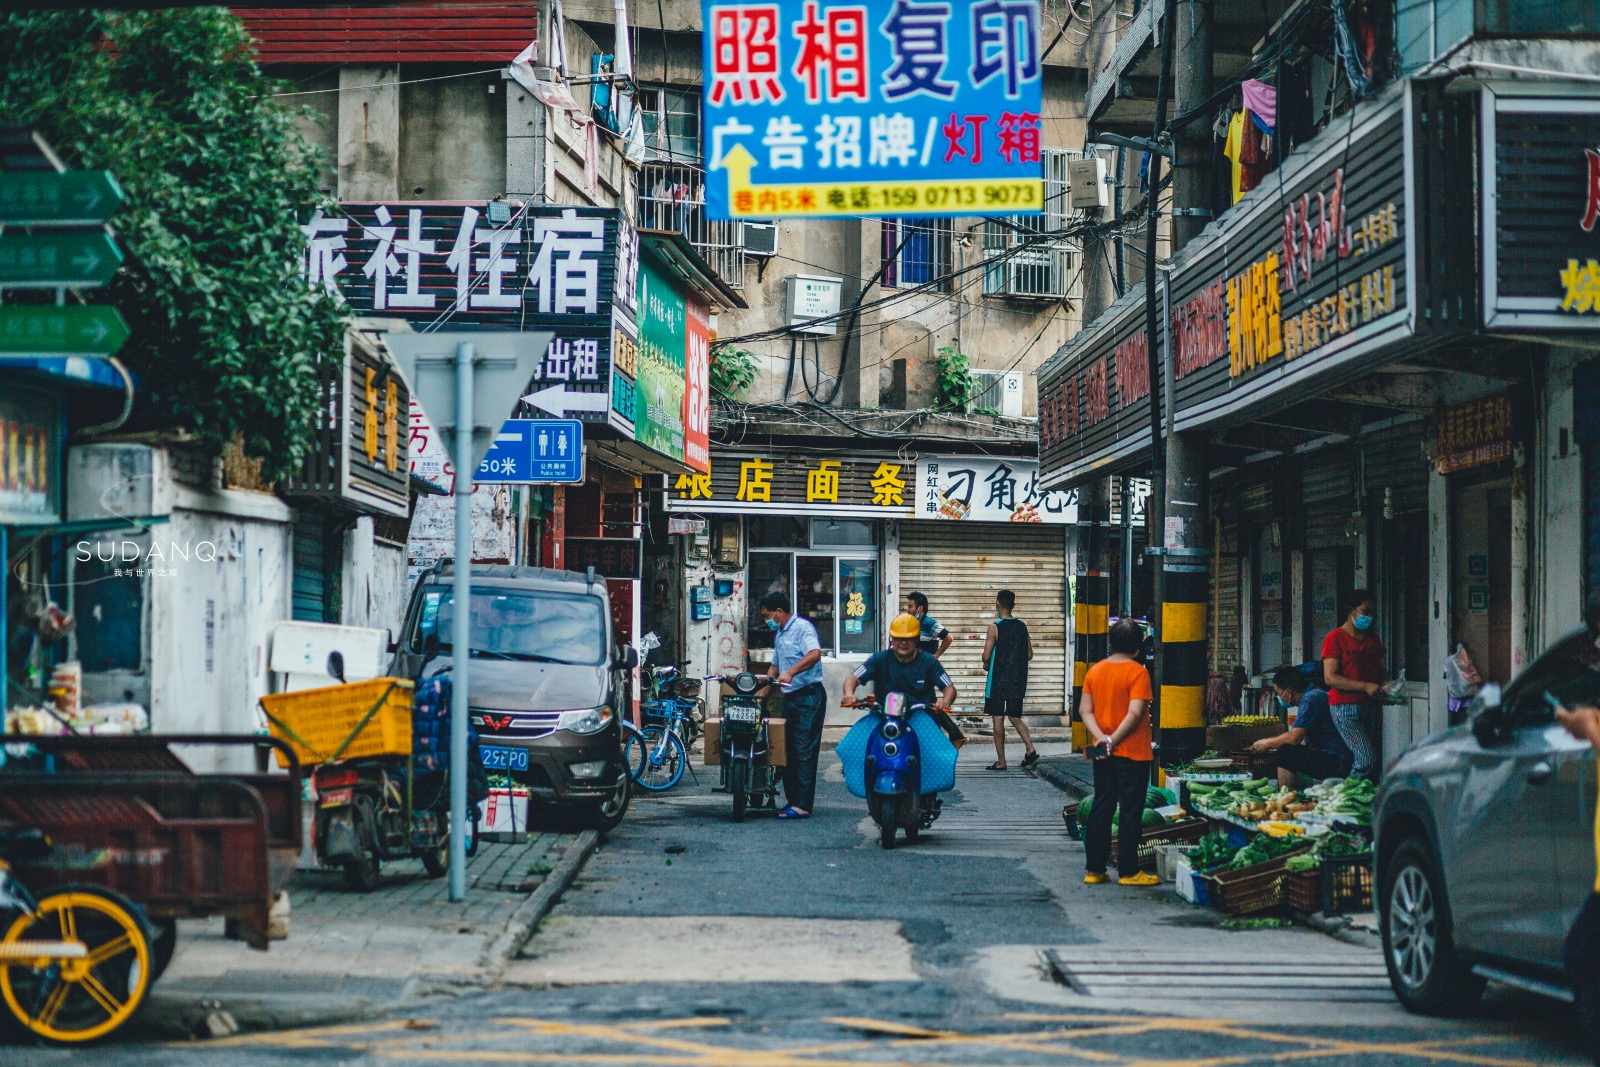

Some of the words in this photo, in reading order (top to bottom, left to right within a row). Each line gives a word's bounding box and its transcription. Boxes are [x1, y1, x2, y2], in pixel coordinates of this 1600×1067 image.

[708, 0, 1042, 107] 照相复印
[735, 189, 817, 212] 巷内5米
[925, 188, 977, 206] 0713
[984, 186, 1036, 204] 9073
[480, 457, 516, 476] 50米
[926, 463, 939, 514] 网红小串
[942, 463, 1078, 513] 刁角烧
